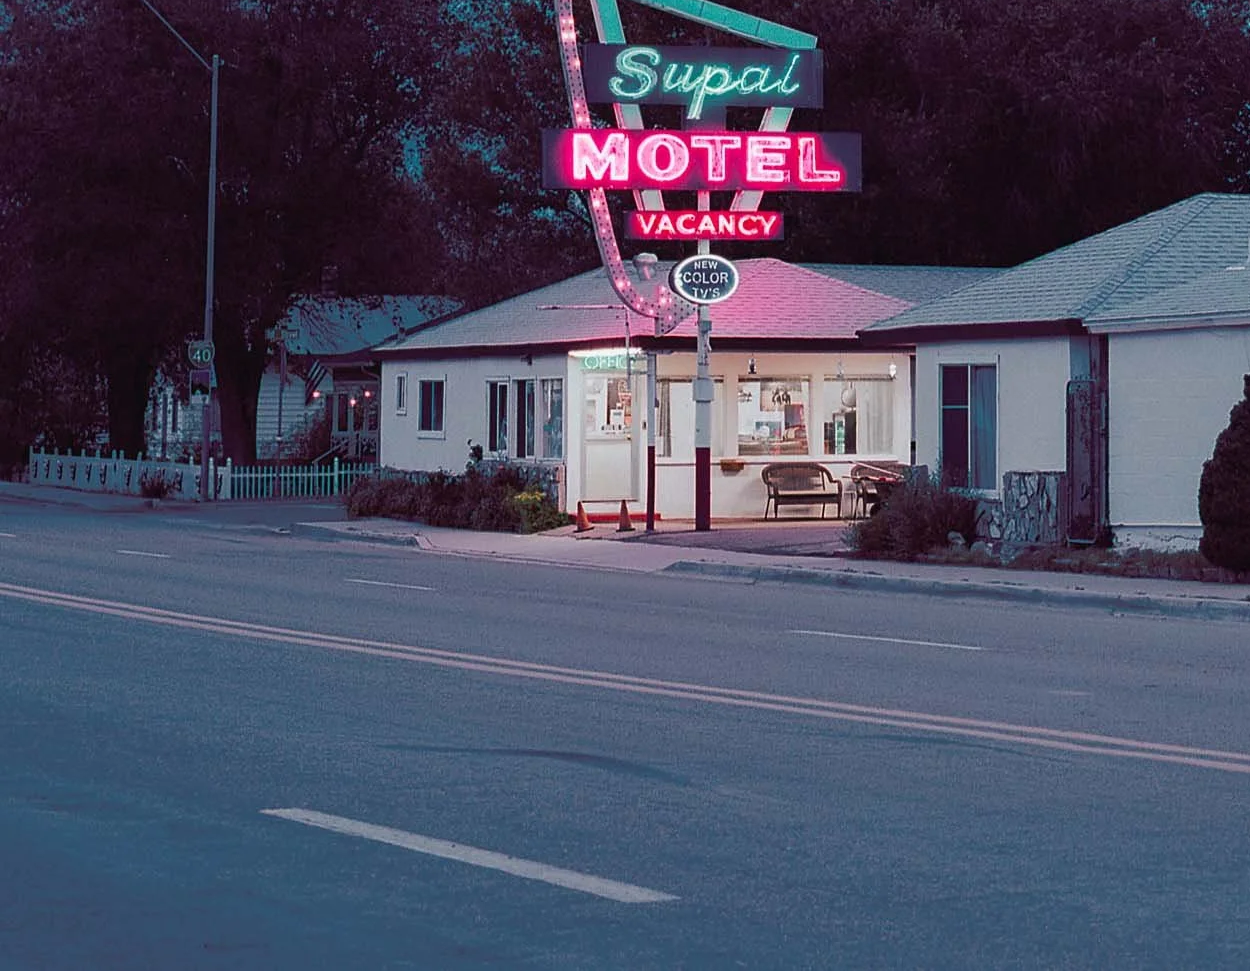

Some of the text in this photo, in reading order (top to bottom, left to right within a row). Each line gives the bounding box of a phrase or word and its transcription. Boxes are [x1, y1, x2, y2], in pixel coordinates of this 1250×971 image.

[572, 133, 841, 183] MOTEL
[636, 213, 777, 236] VACANCY
[694, 260, 718, 270] NEW
[682, 271, 729, 284] COLOR
[692, 287, 720, 299] TV'S
[193, 349, 211, 362] 40
